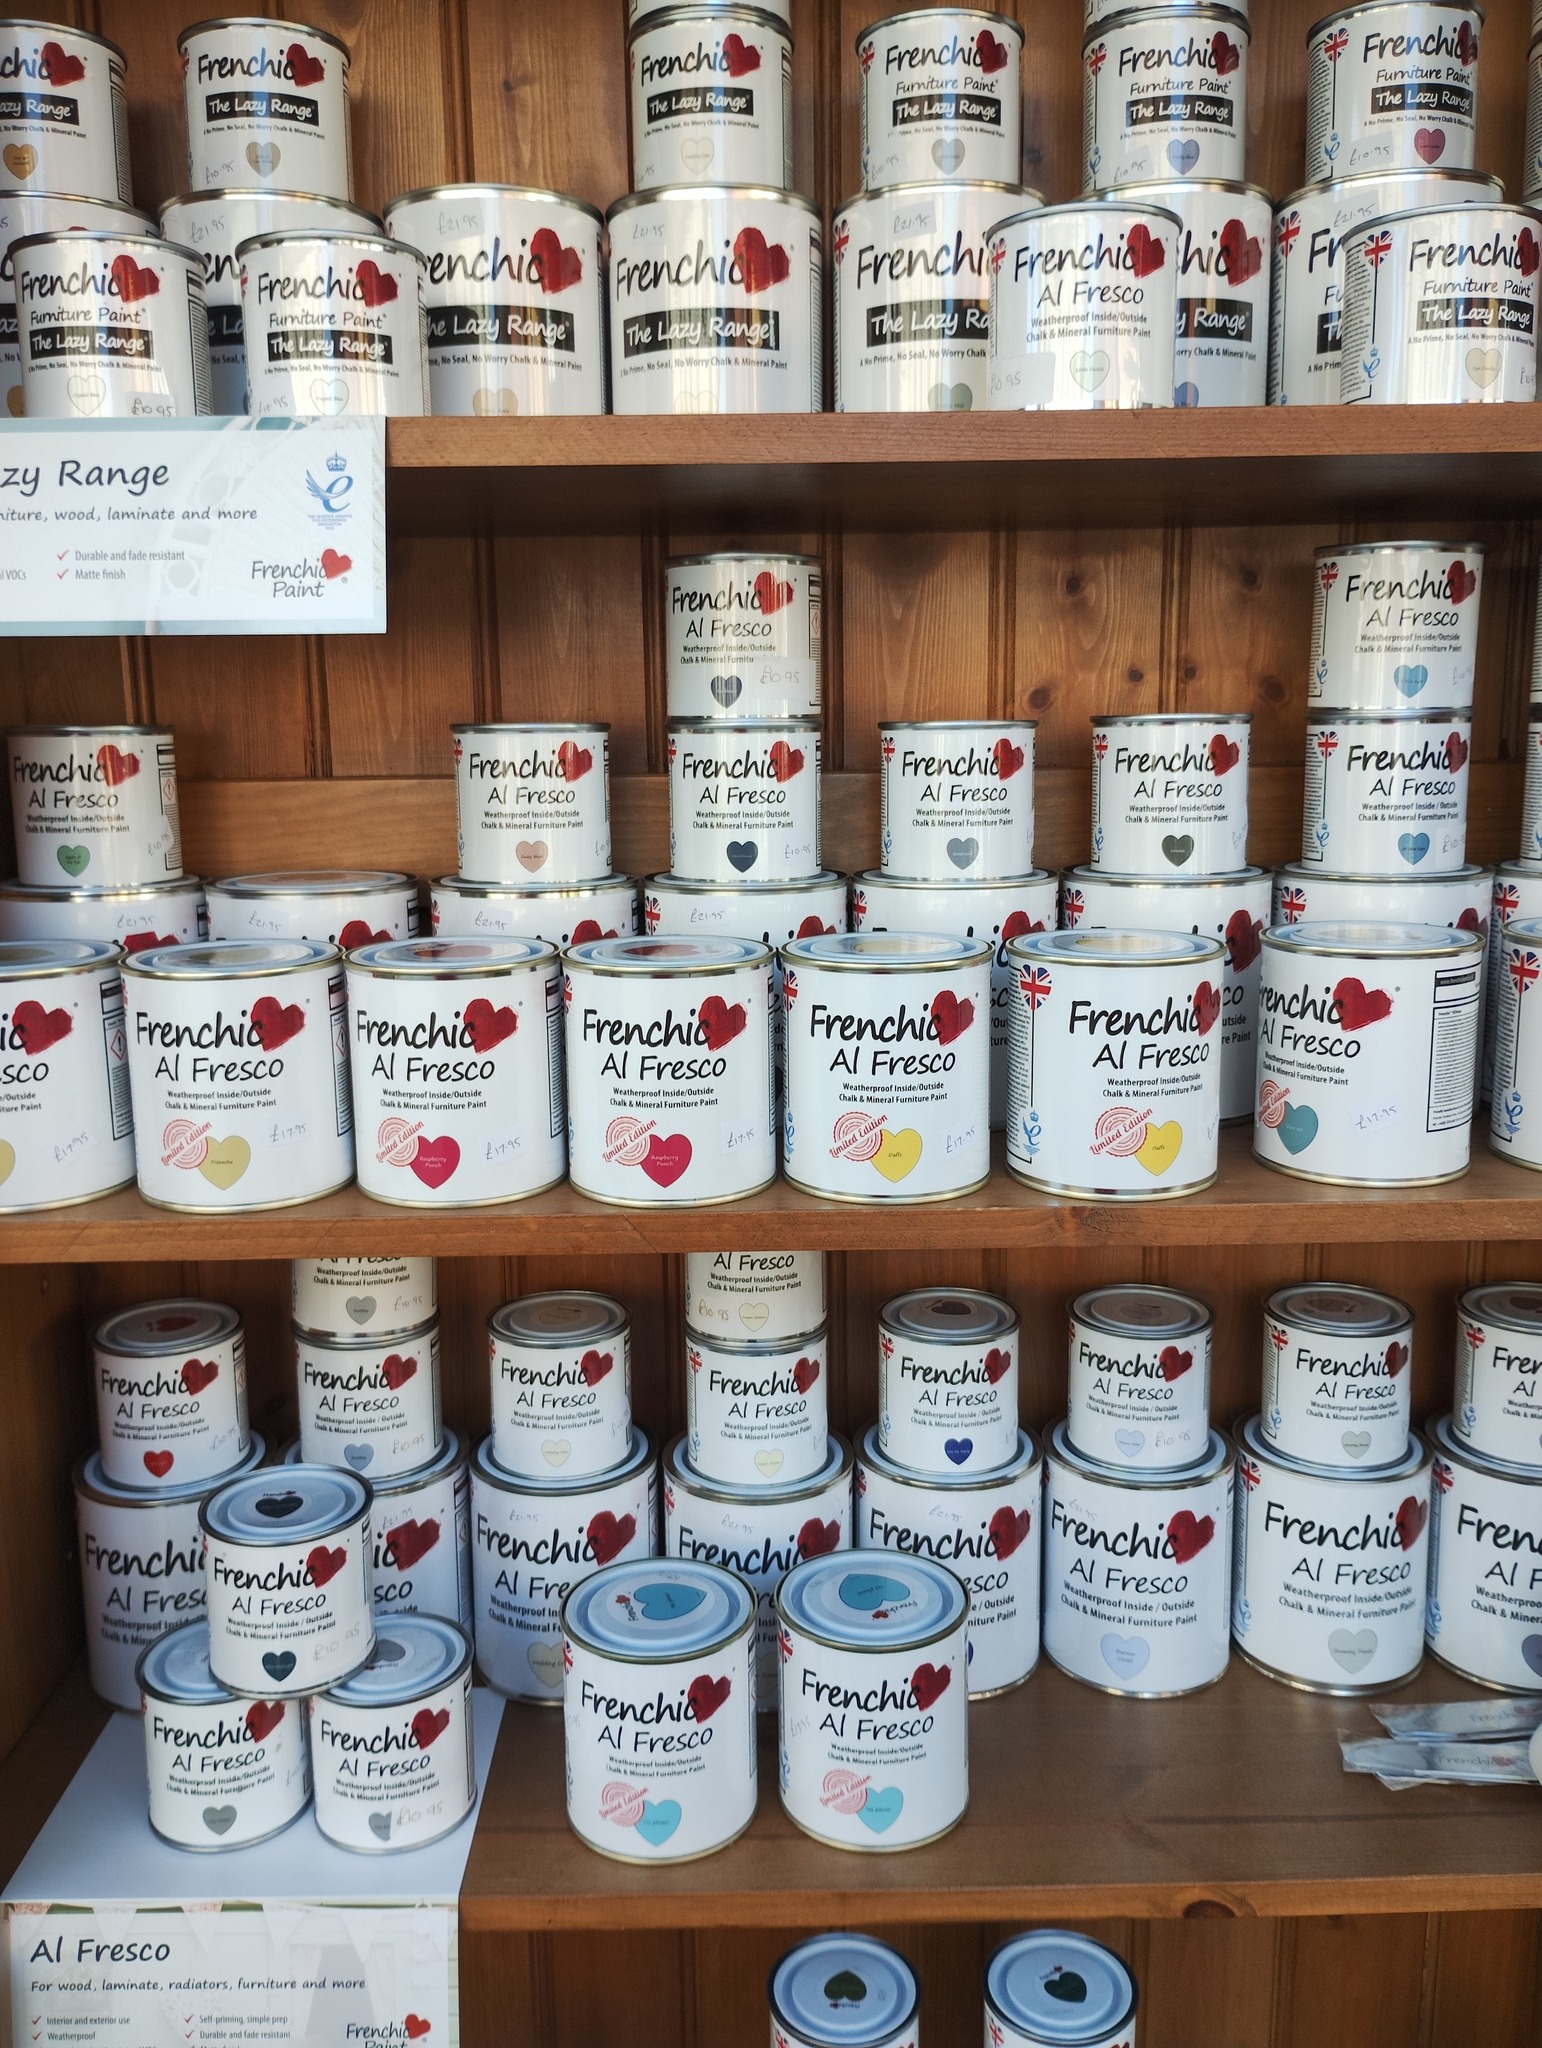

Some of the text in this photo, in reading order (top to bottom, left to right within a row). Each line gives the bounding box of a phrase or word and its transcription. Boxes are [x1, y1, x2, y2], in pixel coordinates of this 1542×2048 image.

[1363, 25, 1462, 63] Frenchic
[198, 47, 295, 84] Frenchic
[642, 41, 731, 87] Frenchic
[1376, 65, 1470, 85] Furniture Paint
[209, 98, 312, 120] The Lazy Range
[1015, 233, 1138, 282] Frenchic
[1410, 233, 1522, 272] Frenchic
[22, 262, 122, 302] Frenchic
[616, 239, 746, 302] Frenchic
[1036, 280, 1143, 308] Al Fresco
[31, 306, 141, 325] Furniture Paint
[1031, 312, 1147, 328] Weatherproof Inside/Outside
[1422, 304, 1530, 328] The Lazy Range
[627, 317, 770, 346] The Lazy Range
[647, 362, 655, 370] No
[657, 361, 672, 369] Seal,
[675, 358, 684, 367] No
[686, 357, 709, 368] Worry
[711, 358, 732, 366] Chalk
[742, 358, 769, 367] Mineral
[771, 360, 788, 370] Paint
[59, 460, 169, 496] Range
[55, 508, 101, 521] wood,
[107, 508, 175, 521] laminate
[182, 508, 210, 520] and
[218, 508, 258, 519] more
[75, 551, 185, 561] Durable and fade resistant
[252, 558, 327, 580] Frenchic
[6, 570, 27, 580] VOCs
[75, 569, 126, 580] Matte finish
[1346, 570, 1454, 602] Frenchic
[273, 581, 324, 598] Paint
[673, 581, 763, 614] Frenchic
[686, 617, 771, 638] Al Fresco
[14, 754, 106, 783] Frenchic
[1115, 743, 1216, 773] Frenchic
[1134, 779, 1222, 799] Al Fresco
[693, 821, 708, 829] Chalk
[696, 811, 741, 820] Weatherproof
[137, 1010, 264, 1049] Frenchic
[584, 1008, 709, 1047] Frenchic
[811, 1003, 942, 1042] Frenchic
[1069, 995, 1200, 1036] Frenchic
[155, 1054, 284, 1082] Al Fresco
[372, 1052, 495, 1082] Al Fresco
[830, 1046, 955, 1075] Al Fresco
[1092, 1041, 1209, 1069] Al Fresco
[610, 1098, 627, 1108] Chalk
[636, 1100, 663, 1109] Mineral
[665, 1100, 698, 1108] Furniture
[700, 1098, 718, 1107] Paint
[613, 1087, 714, 1098] Weatherproof Inside/Outside
[376, 1121, 424, 1163] Limited Edition
[829, 1115, 888, 1158] Limited Edition
[714, 1252, 794, 1270] Al Fresco
[501, 1358, 588, 1386] Frenchic
[1079, 1342, 1167, 1378] Frenchic
[1296, 1349, 1390, 1377] Frenchic
[101, 1370, 190, 1396] Frenchic
[304, 1362, 390, 1391] Frenchic
[517, 1391, 596, 1409] Al Fresco
[1052, 1499, 1177, 1559] Frenchic
[1265, 1501, 1404, 1551] Frenchic
[214, 1557, 316, 1591] Frenchic
[1070, 1558, 1188, 1594] Al Fresco
[1292, 1558, 1411, 1586] Al Fresco
[232, 1594, 326, 1615] Al Fresco
[1064, 1580, 1122, 1608] Weatherproof
[1125, 1601, 1153, 1611] Inside
[1162, 1600, 1194, 1611] Outside
[582, 1680, 698, 1724] Frenchic
[802, 1668, 920, 1712] Frenchic
[153, 1717, 256, 1749] Frenchic
[321, 1719, 421, 1753] Frenchic
[598, 1726, 713, 1753] Al Fresco
[819, 1714, 933, 1740] Al Fresco
[30, 1935, 170, 1963] Al Fresco
[31, 1978, 365, 1992] For wood, laminate, radiators, furniture and more
[47, 2017, 73, 2025] Interior
[75, 2016, 88, 2024] and
[90, 2016, 116, 2024] exterior
[200, 2014, 288, 2025] Self-priming, simple prep
[347, 2022, 410, 2039] Frenchic
[48, 2032, 95, 2041] Weatherproof
[200, 2030, 290, 2039] Durable and fade resistant
